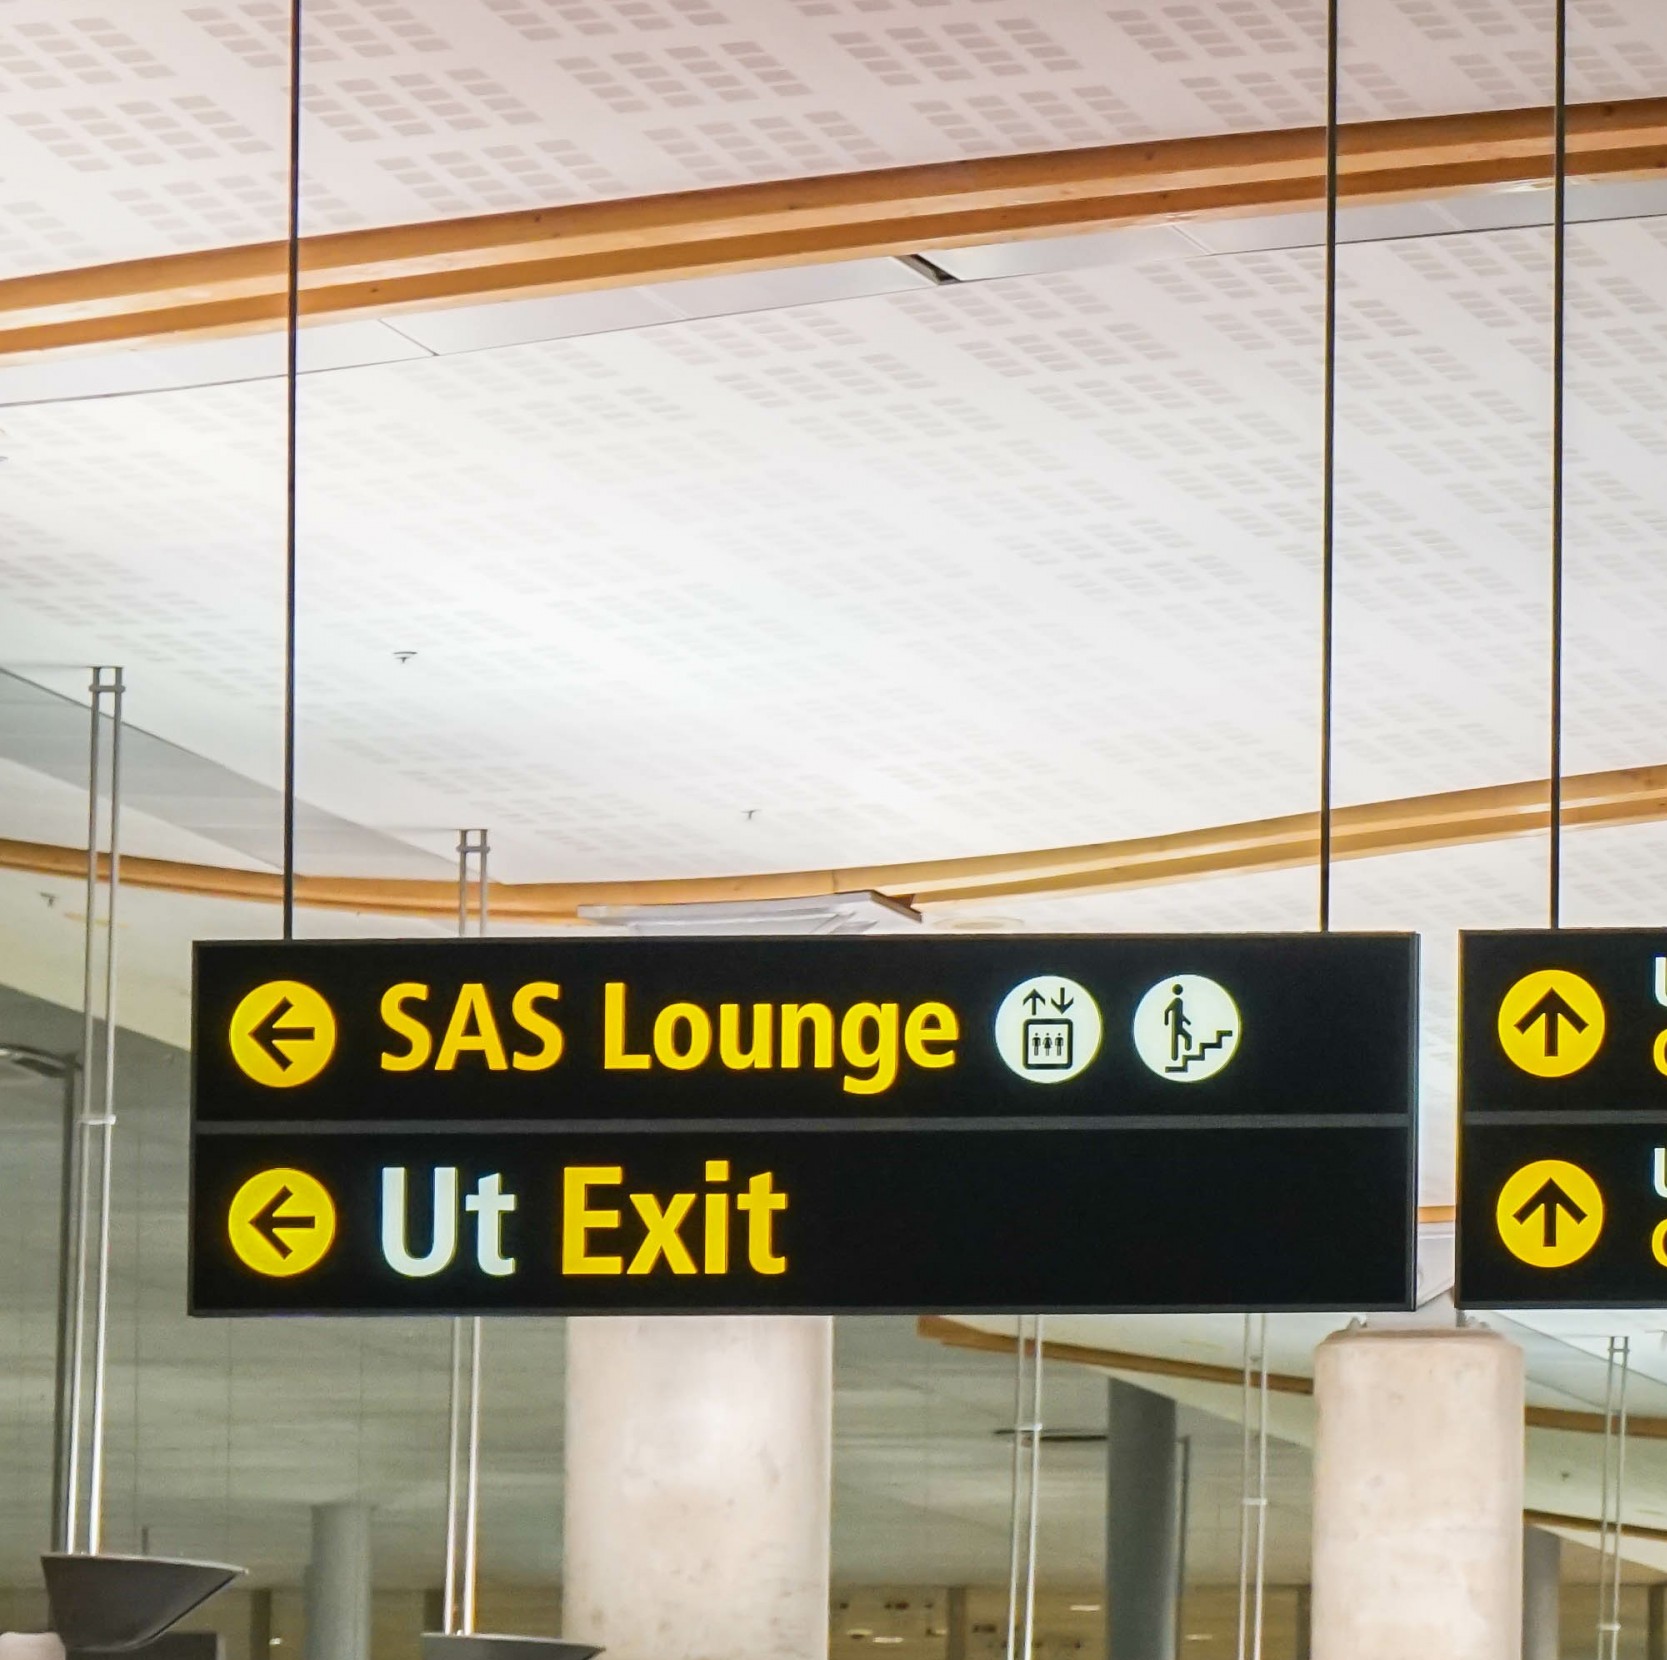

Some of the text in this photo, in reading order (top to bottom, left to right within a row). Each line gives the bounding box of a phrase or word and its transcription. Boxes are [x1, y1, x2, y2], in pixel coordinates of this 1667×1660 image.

[379, 980, 960, 1095] SAS Lounge
[381, 1159, 789, 1278] Ut Exit
